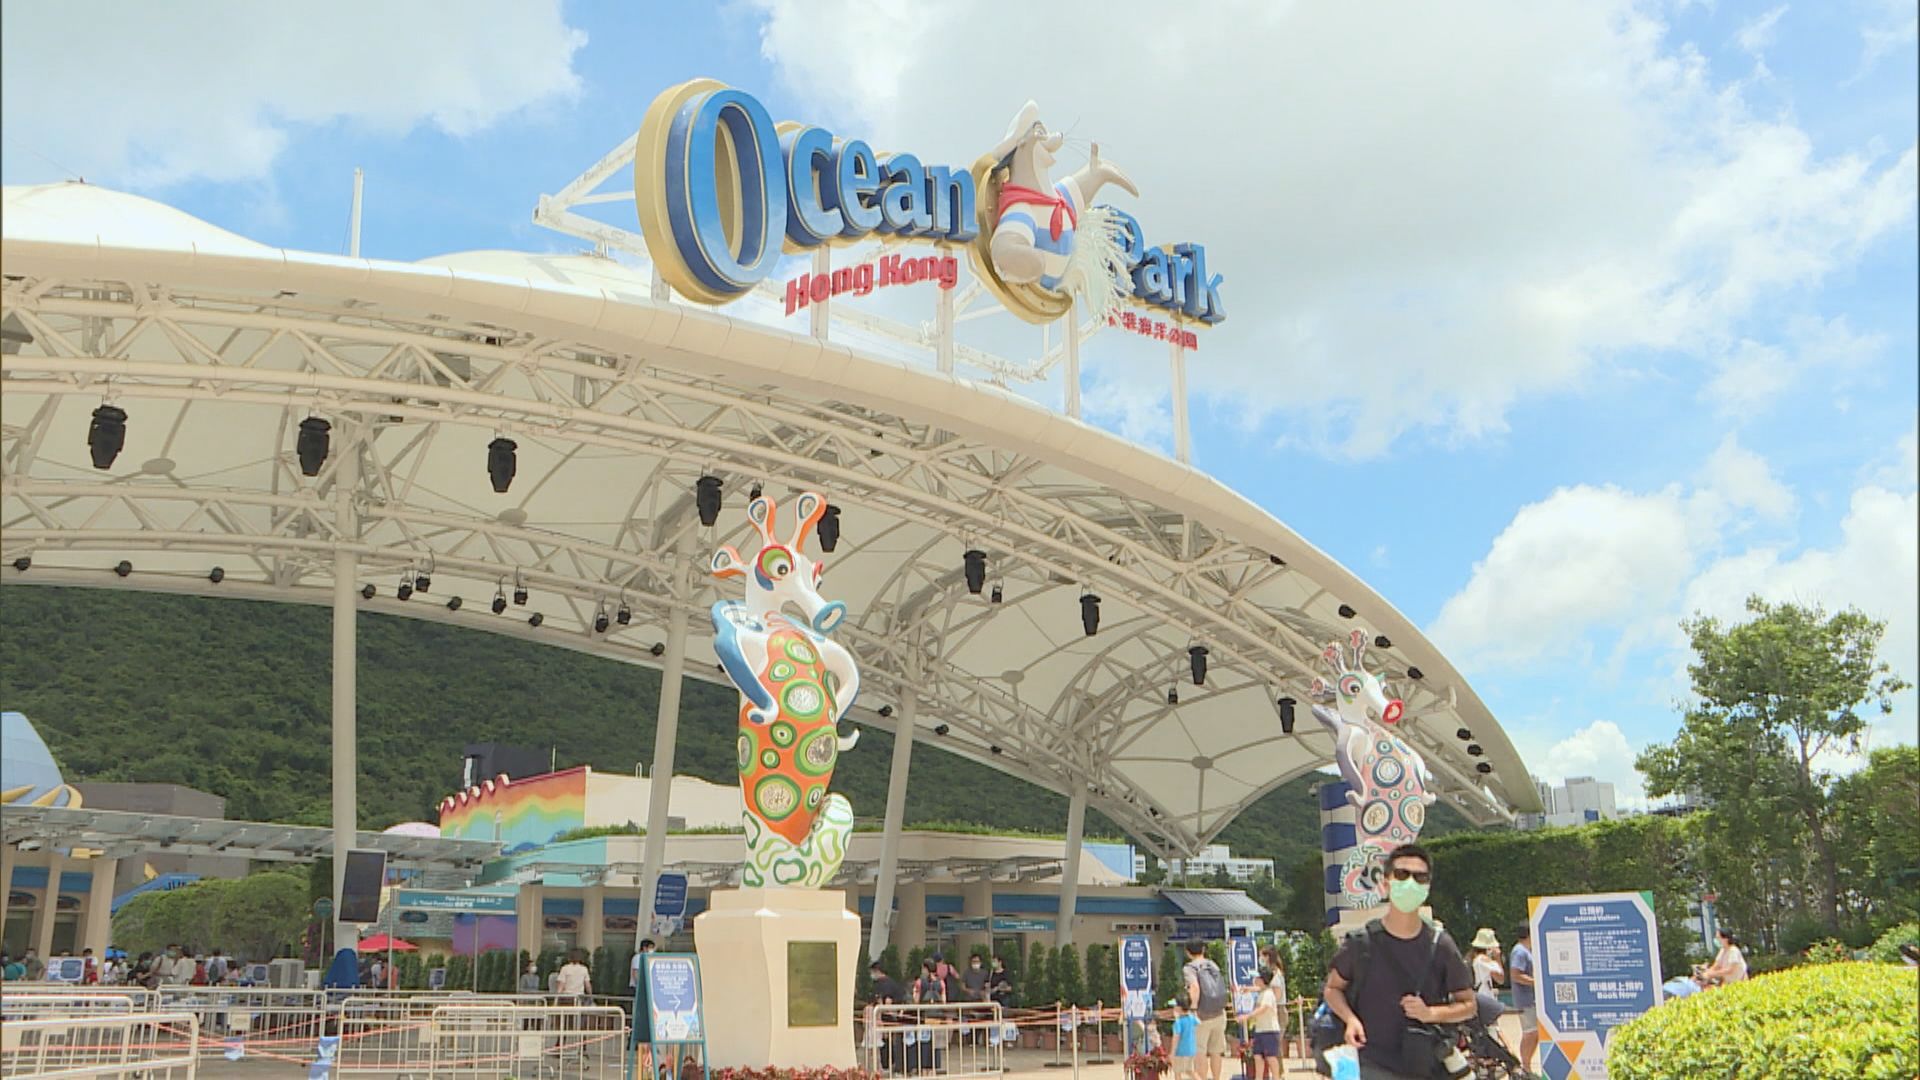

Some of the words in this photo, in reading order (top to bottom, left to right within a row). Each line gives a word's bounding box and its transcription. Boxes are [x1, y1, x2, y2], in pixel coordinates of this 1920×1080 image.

[637, 79, 978, 303] Ocean
[1093, 204, 1226, 325] Park
[785, 263, 874, 317] Hong
[879, 254, 958, 290] Kong
[1564, 915, 1597, 924] Registered
[1598, 914, 1620, 922] Visitors
[1597, 992, 1618, 1000] Book
[1619, 991, 1638, 999] Now
